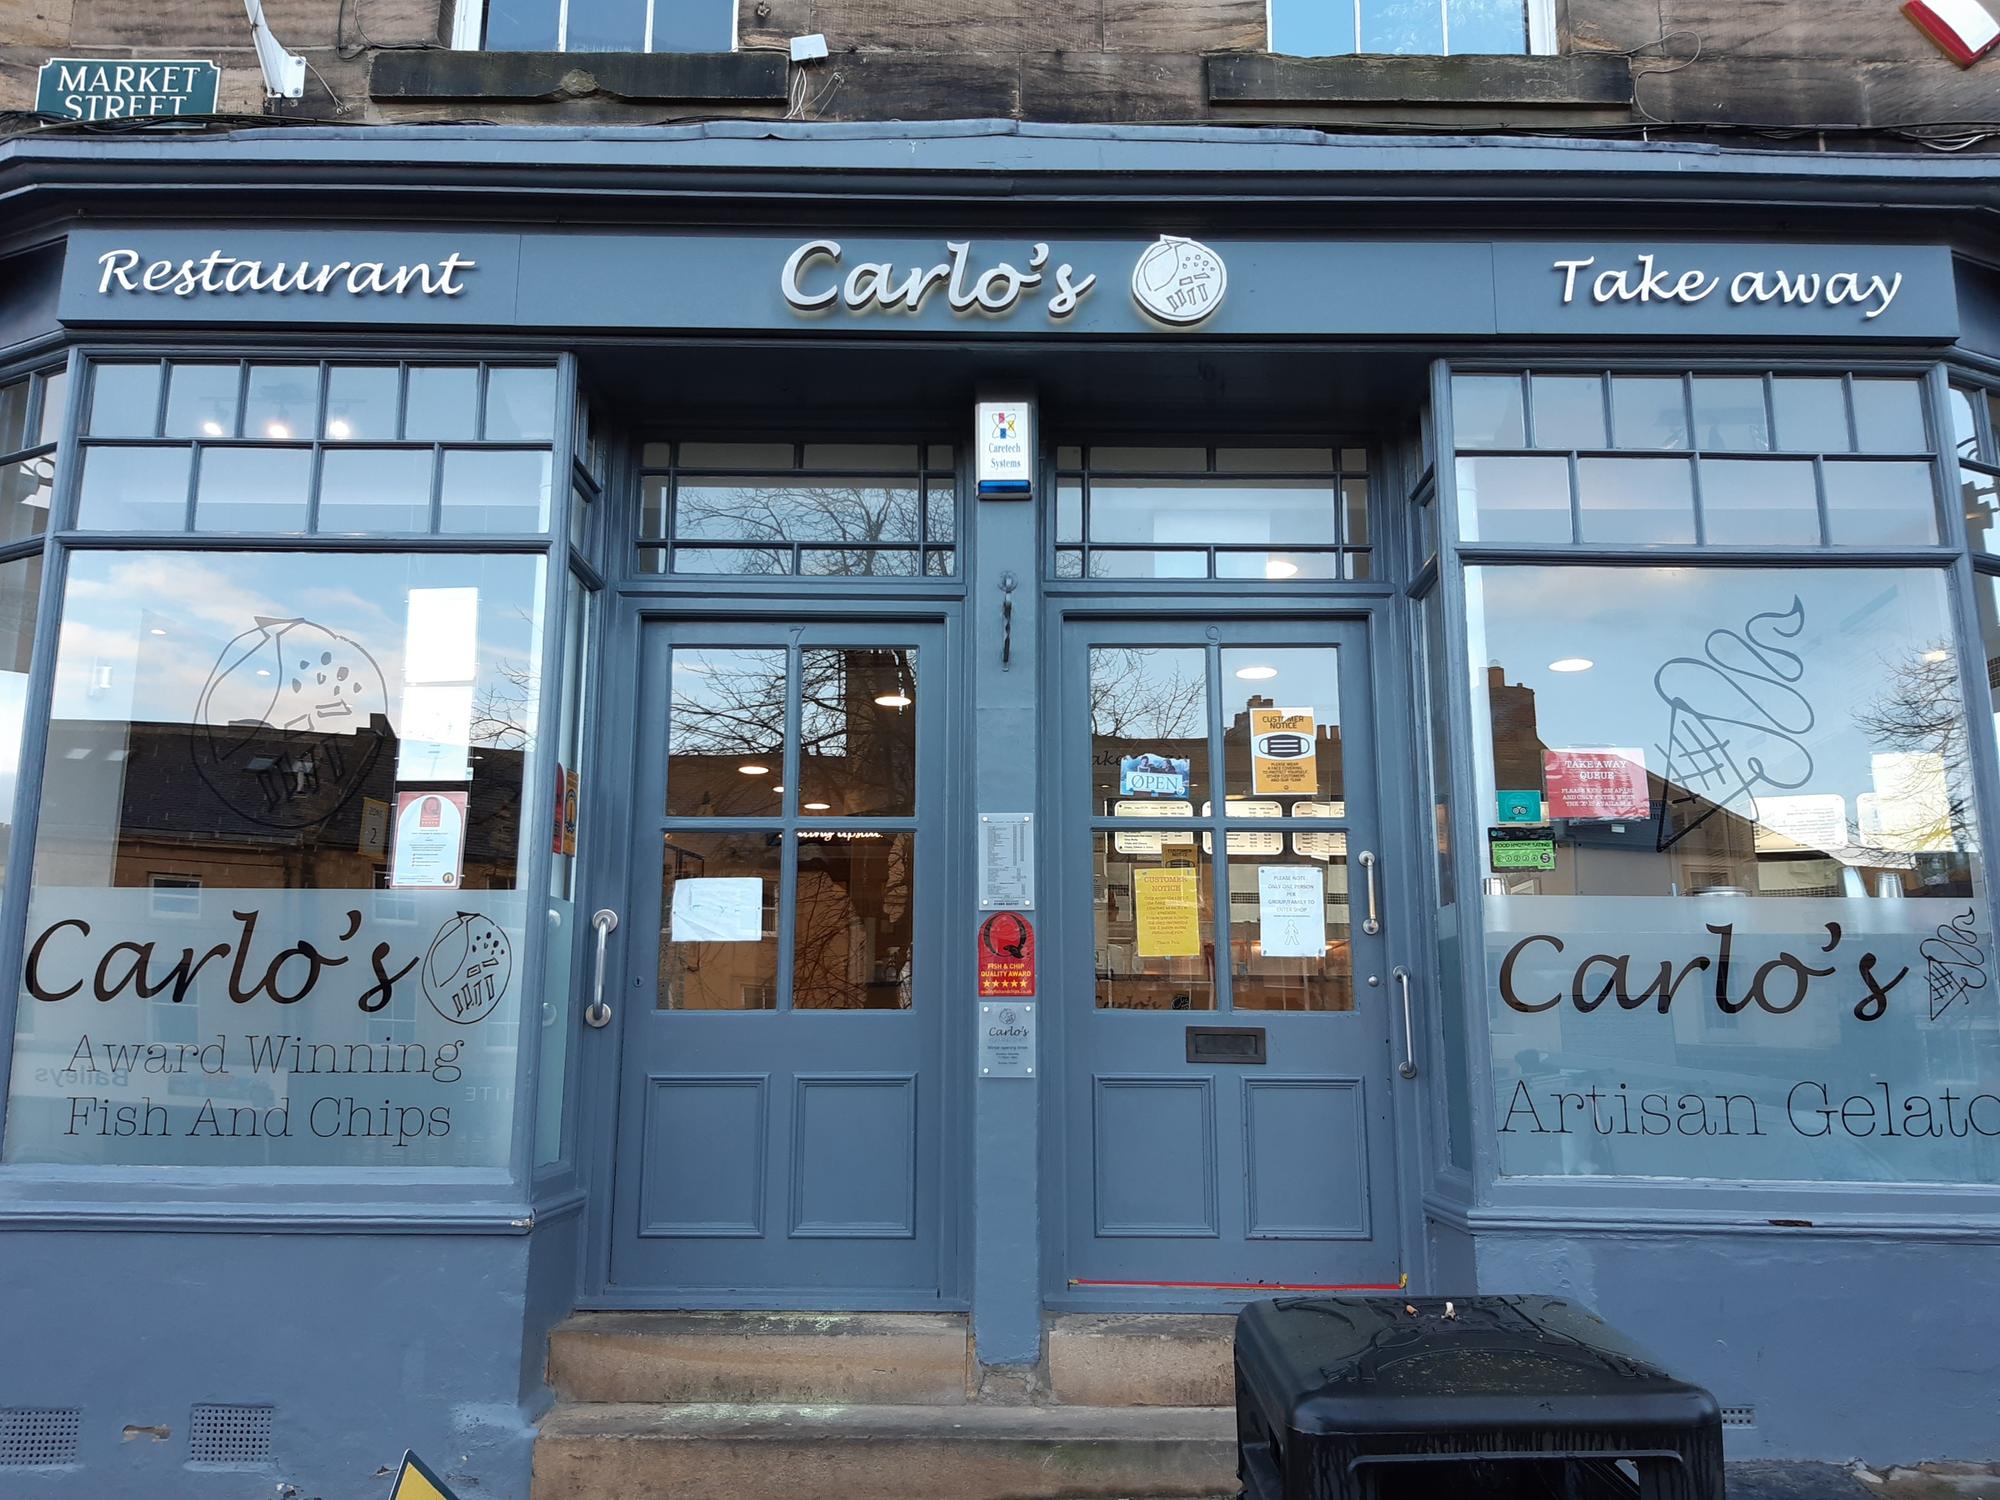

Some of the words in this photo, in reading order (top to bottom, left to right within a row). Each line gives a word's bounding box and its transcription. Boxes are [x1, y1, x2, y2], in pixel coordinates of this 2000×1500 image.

[57, 65, 201, 93] MARKET
[63, 95, 187, 121] STREET
[97, 249, 476, 296] Restaurant
[780, 239, 1096, 317] Carlo's
[1553, 254, 1720, 303] Take
[1730, 270, 1903, 318] away
[988, 443, 1021, 453] Caretech
[990, 458, 1021, 470] Systems
[1564, 760, 1594, 769] TAKE
[1596, 760, 1628, 769] AWAY
[1579, 771, 1616, 781] QUEUE
[24, 909, 419, 1013] Carlo's
[1499, 922, 1909, 1022] Carlo's
[989, 1026, 1030, 1037] Carlo's
[61, 1034, 229, 1075] Award
[245, 1034, 465, 1083] Winning
[63, 1096, 171, 1137] Fish
[185, 1098, 294, 1138] And
[310, 1098, 452, 1147] Chips
[1498, 1080, 1768, 1137] Artisan
